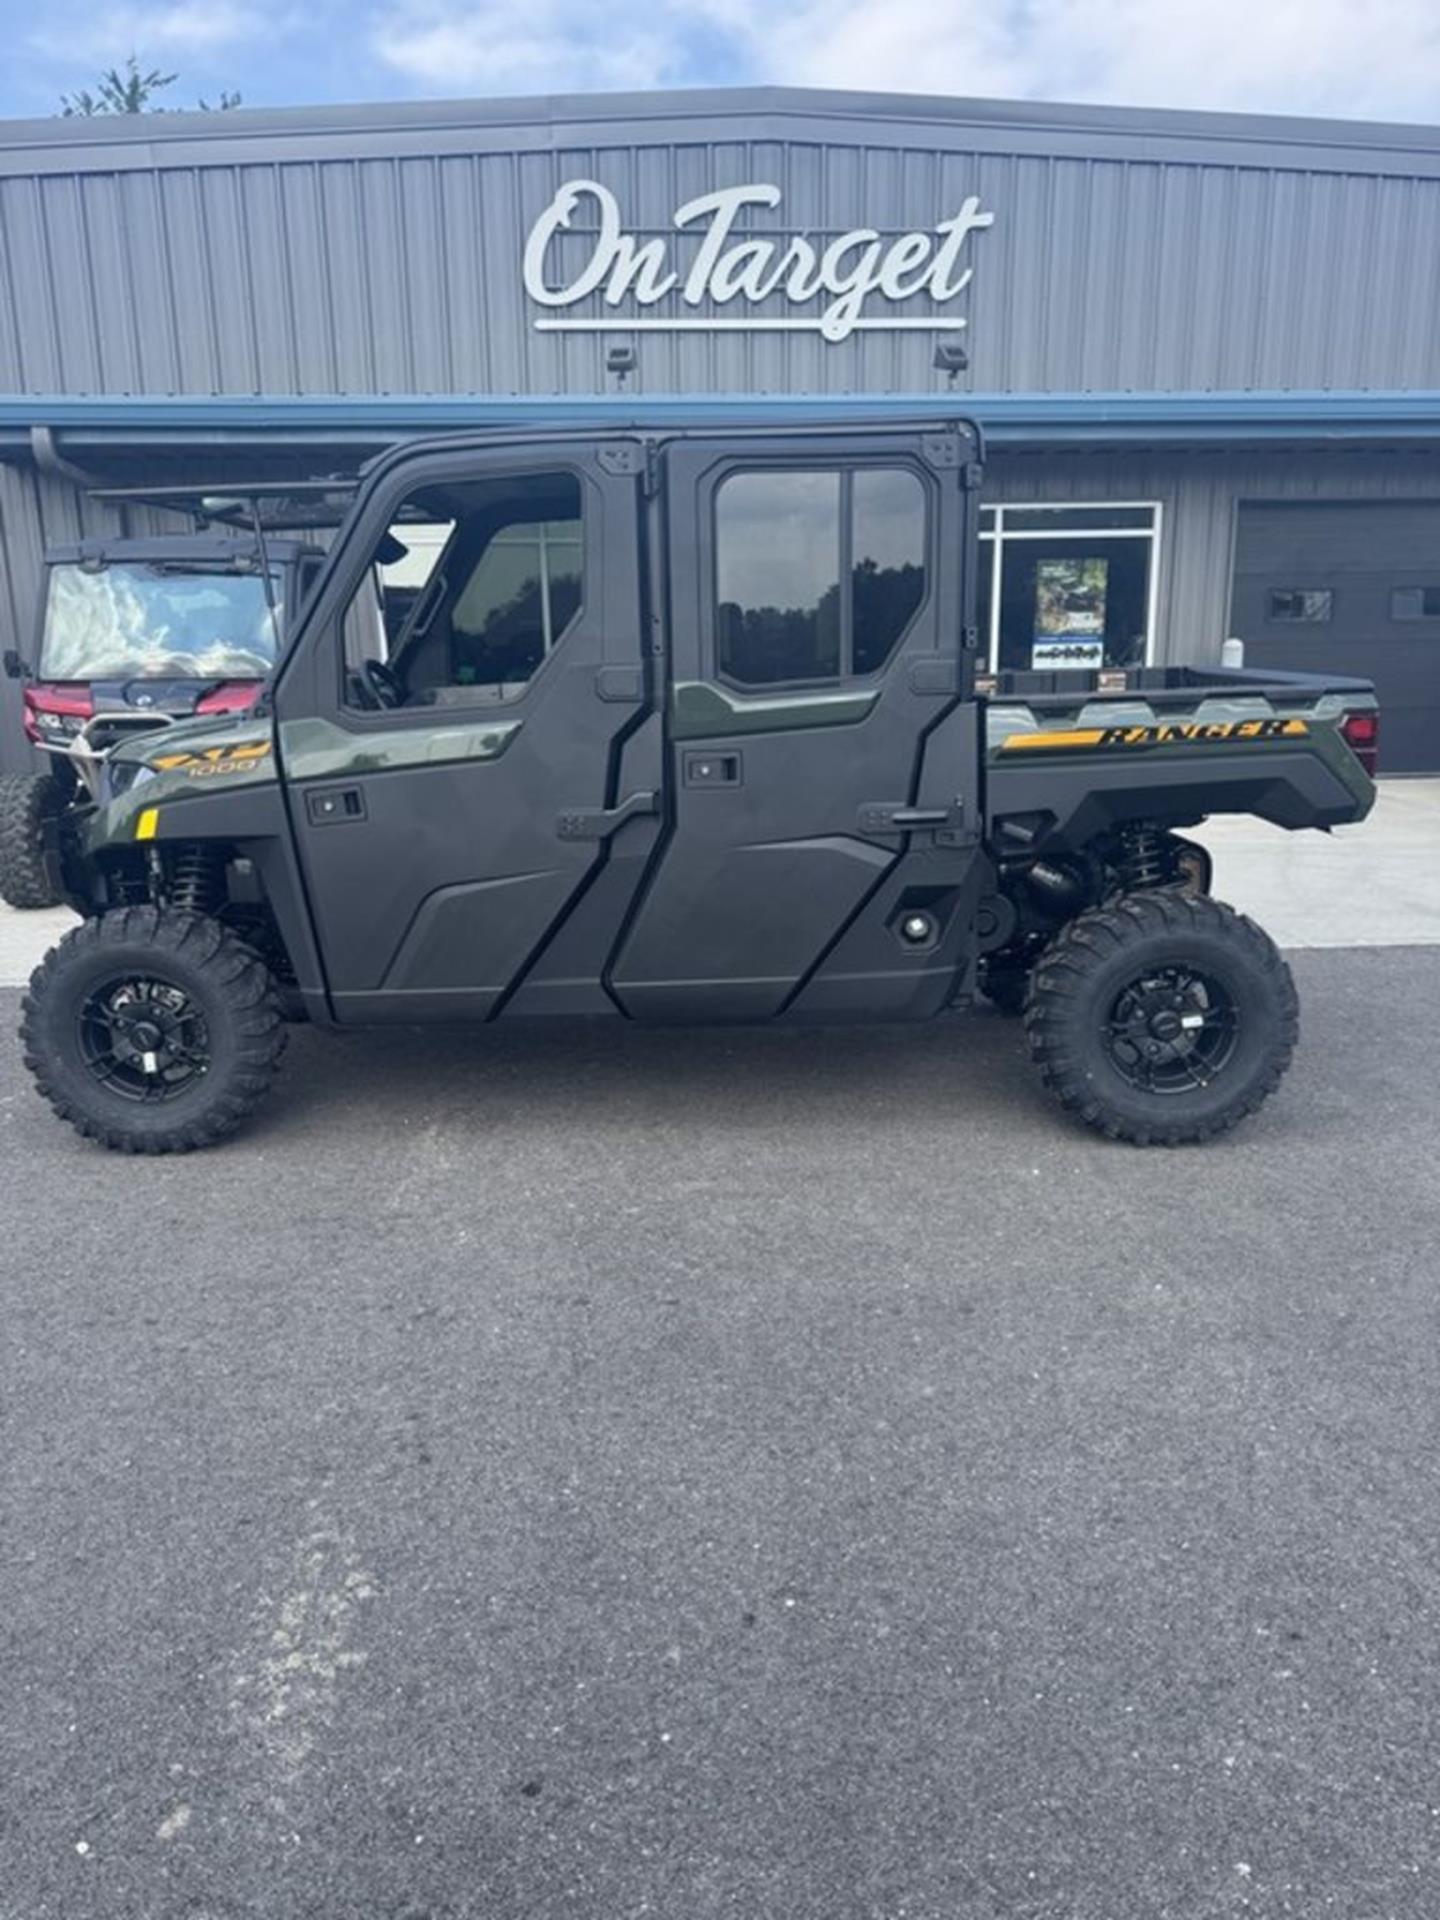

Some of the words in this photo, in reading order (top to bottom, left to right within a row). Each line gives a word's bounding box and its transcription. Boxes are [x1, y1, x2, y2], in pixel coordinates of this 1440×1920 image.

[523, 179, 677, 306] On
[674, 184, 995, 342] Target
[1097, 719, 1292, 744] RANGER
[189, 759, 258, 777] 1000
